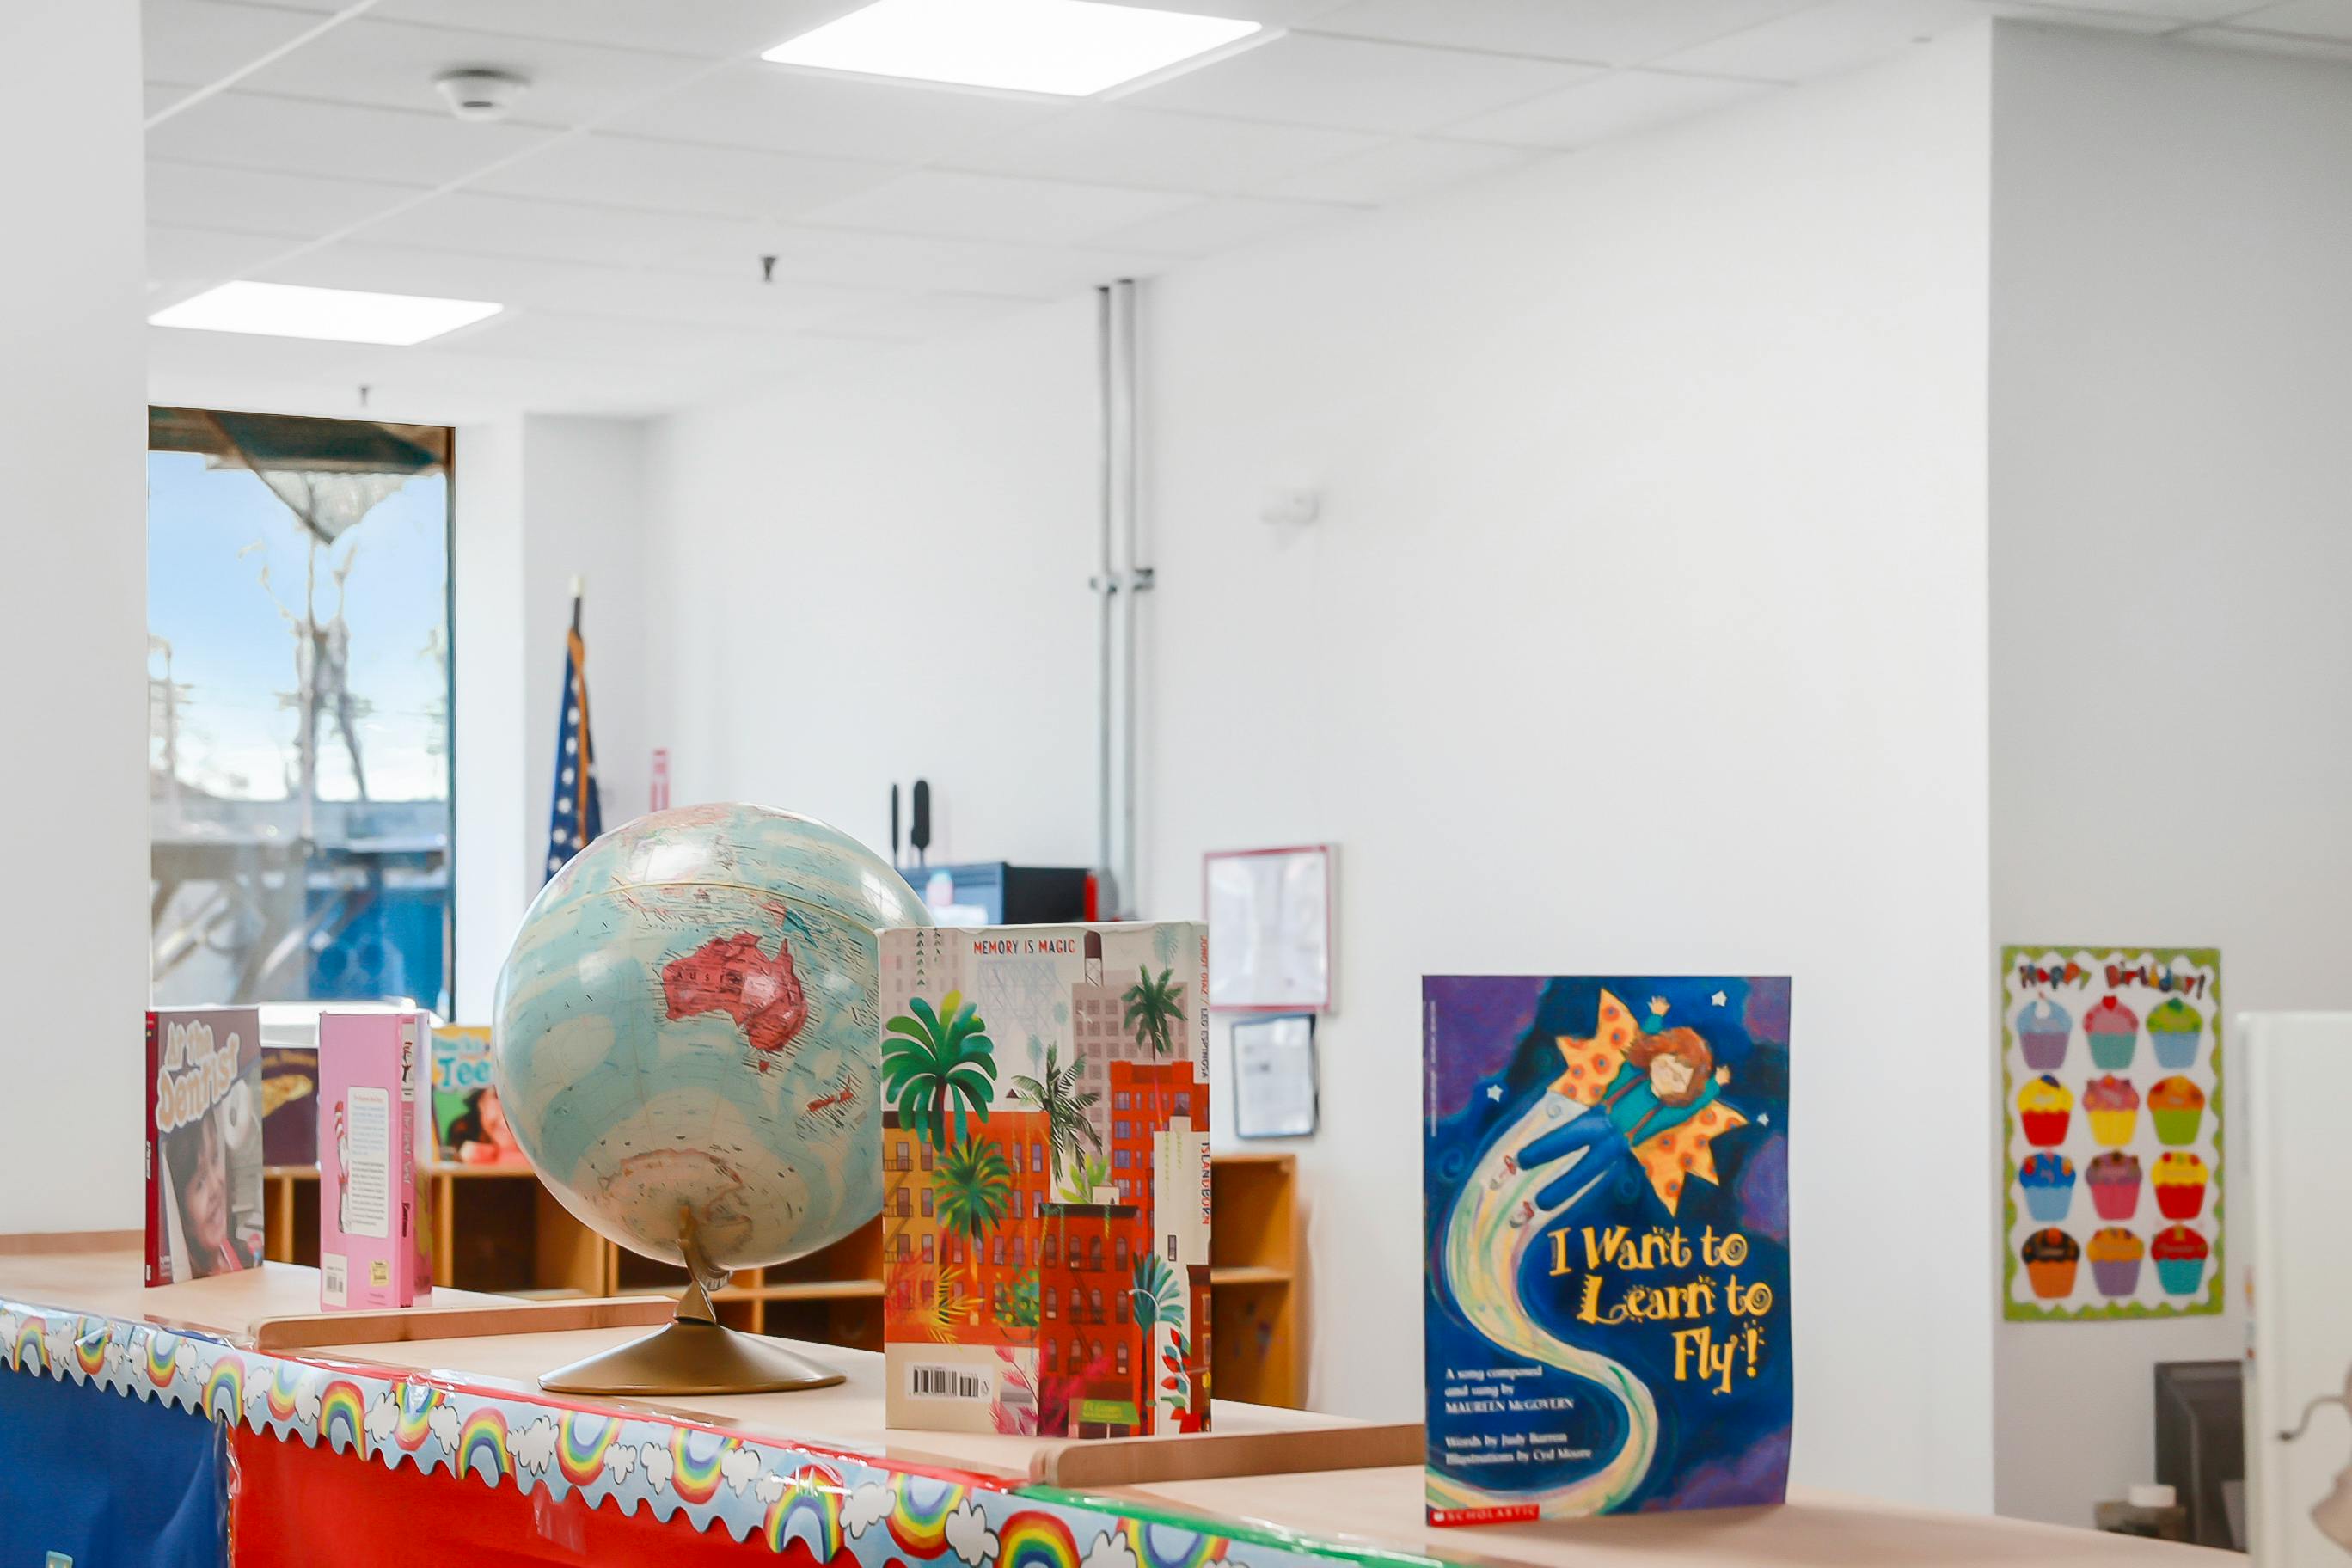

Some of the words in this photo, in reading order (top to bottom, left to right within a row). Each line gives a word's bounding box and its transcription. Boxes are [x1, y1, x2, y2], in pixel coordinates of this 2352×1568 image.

[974, 940, 1018, 954] MEMORY
[1024, 940, 1034, 953] IS
[1038, 939, 1075, 953] MAGIC
[1547, 1227, 1572, 1276] I
[1581, 1225, 1692, 1271] Want
[1700, 1225, 1749, 1267] to
[1577, 1273, 1716, 1325] Learn
[1724, 1274, 1773, 1317] to
[1671, 1324, 1762, 1395] Fly!
[1446, 1368, 1455, 1380] A
[1486, 1364, 1543, 1381] composed
[1444, 1384, 1468, 1397] and
[1500, 1383, 1514, 1395] by
[1445, 1434, 1482, 1448] Words
[1484, 1434, 1498, 1448] by
[1516, 1449, 1529, 1461] by
[1446, 1506, 1535, 1522] SCHOLASTIC
